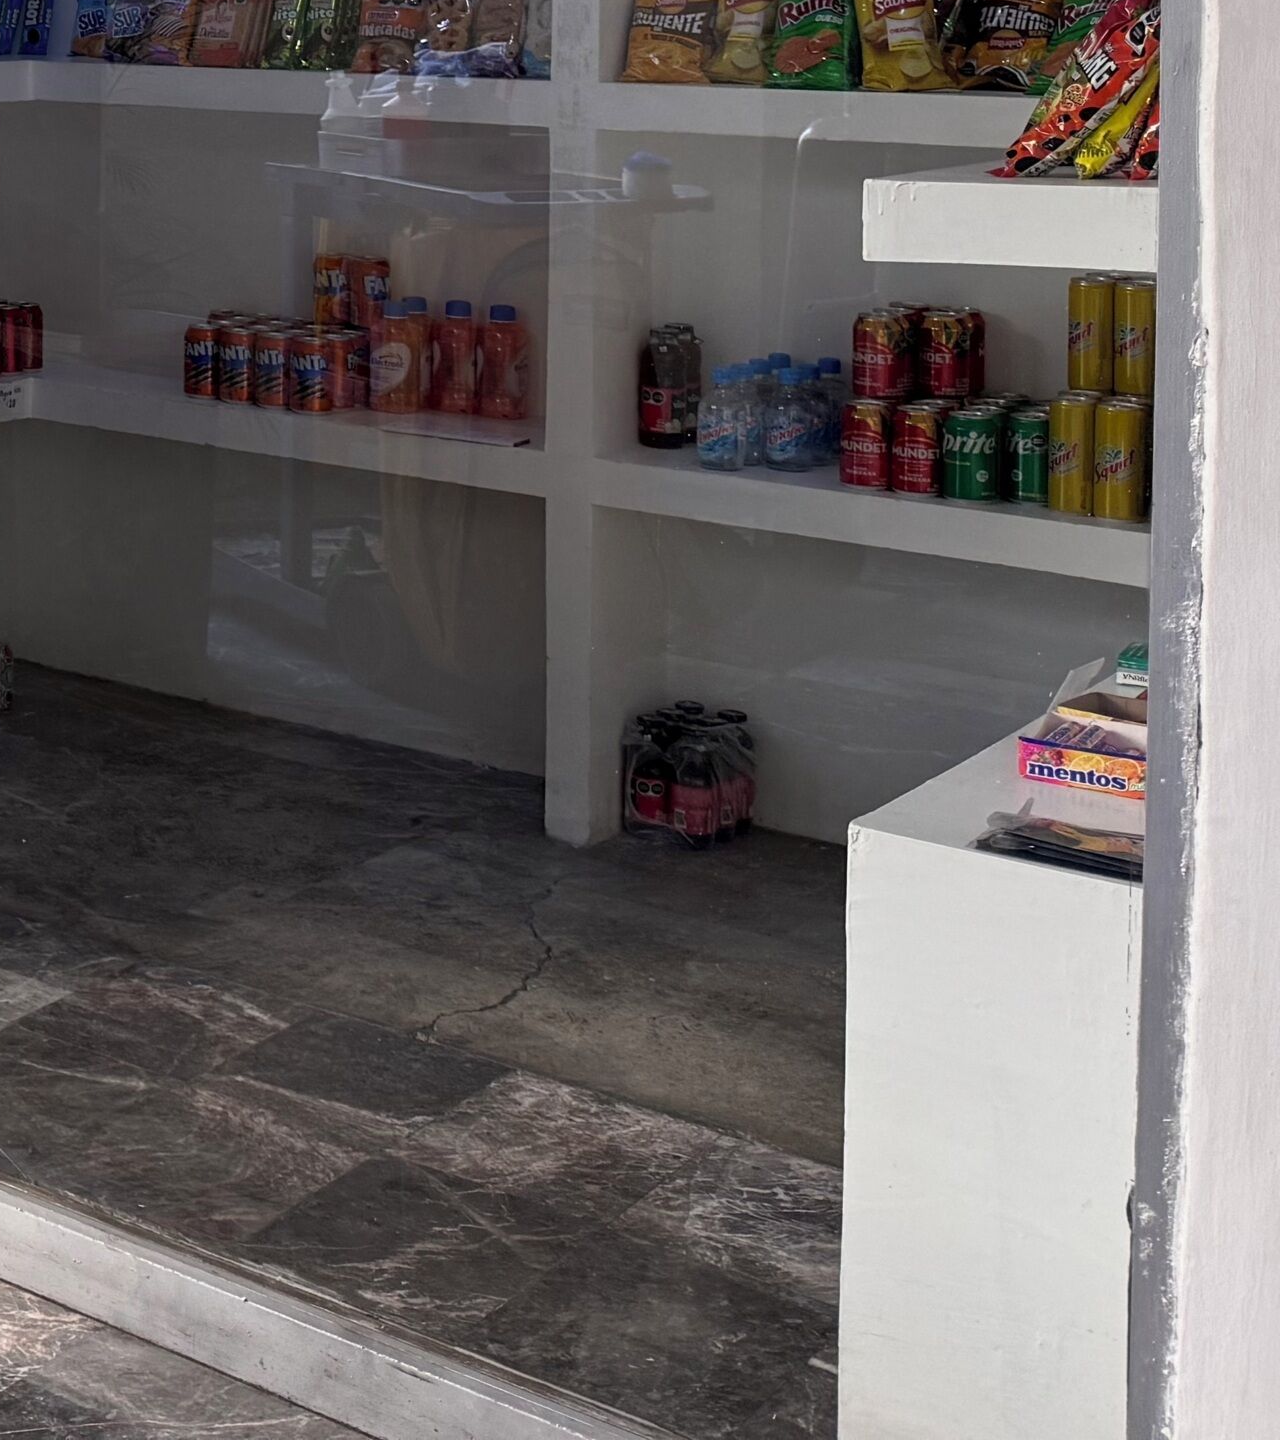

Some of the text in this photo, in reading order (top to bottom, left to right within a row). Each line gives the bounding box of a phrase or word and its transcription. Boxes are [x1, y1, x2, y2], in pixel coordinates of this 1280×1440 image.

[78, 9, 105, 31] SUB
[113, 7, 141, 28] SUB
[306, 8, 335, 22] Nito
[315, 269, 347, 288] NTA
[1068, 321, 1093, 350] quirt
[942, 428, 996, 455] prite
[1049, 443, 1080, 473] quirt
[1095, 448, 1138, 485] Squirt
[1028, 762, 1128, 791] mentos
